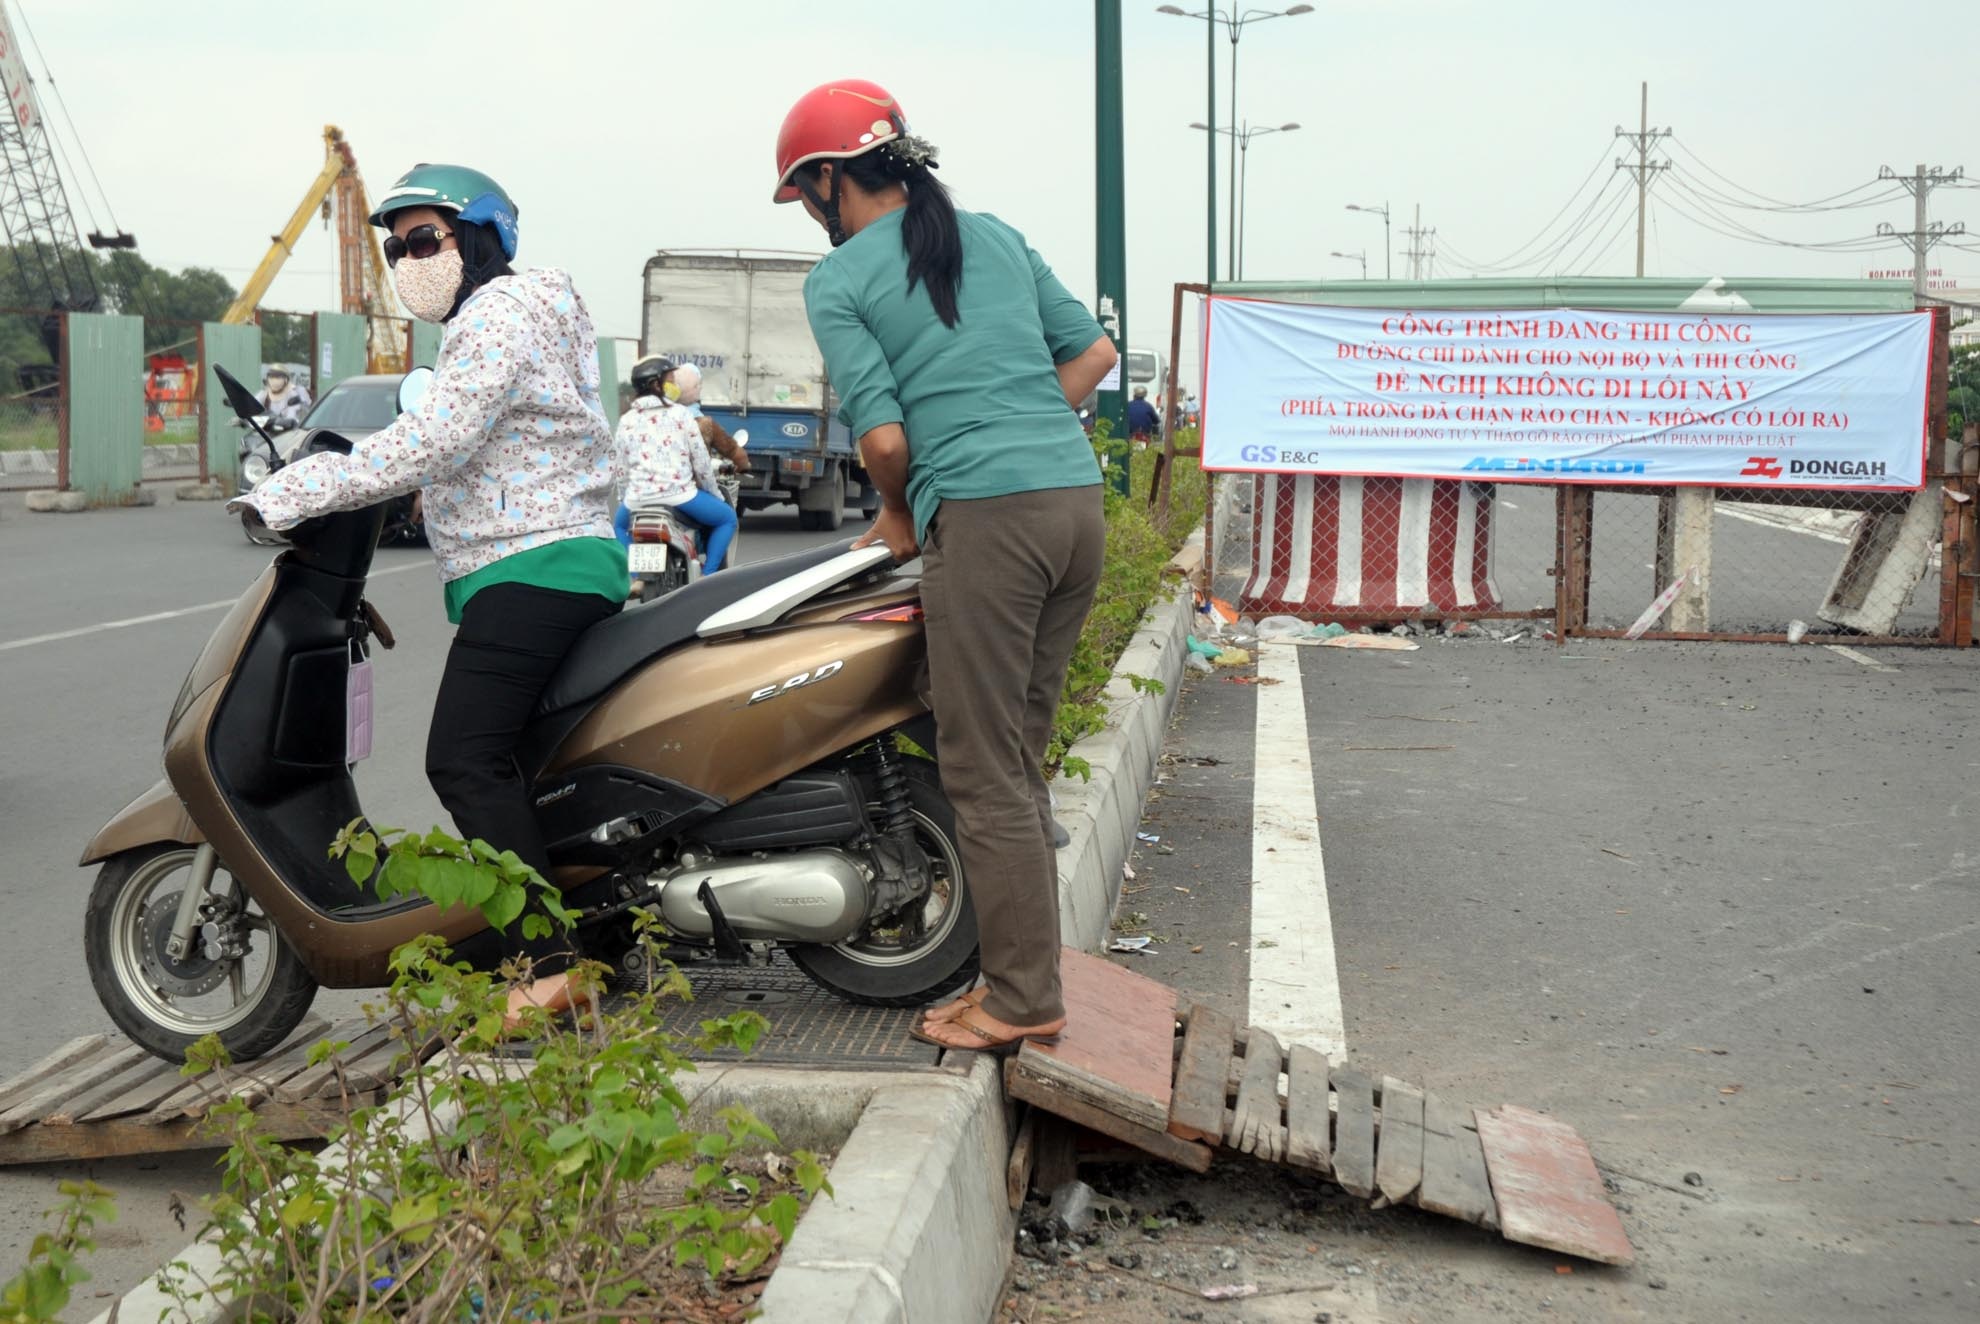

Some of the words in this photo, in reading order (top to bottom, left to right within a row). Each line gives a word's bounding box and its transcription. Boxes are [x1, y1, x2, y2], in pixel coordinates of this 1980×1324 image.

[1382, 312, 1454, 337] CÔNG
[1462, 314, 1539, 339] TRÌNH
[1627, 322, 1670, 341] THI
[1678, 317, 1752, 343] CÔNG
[661, 352, 724, 369] 0N-7374
[1461, 344, 1520, 364] DÀNH
[1525, 349, 1573, 366] CHO
[1657, 347, 1685, 368] VÀ
[1692, 352, 1728, 369] THI
[1734, 349, 1797, 370] CÔNG
[1418, 373, 1487, 400] NGHỊ
[1495, 370, 1596, 398] KHÔNG
[1697, 375, 1754, 401] NÀY
[1281, 396, 1337, 417] (PHÍA
[1344, 401, 1416, 420] TRONG
[1520, 403, 1565, 423] RÀO
[1647, 407, 1726, 427] KHÔNG
[1731, 405, 1763, 427] CÓ
[1812, 411, 1850, 432] RA)
[1241, 445, 1277, 463] GS
[1280, 450, 1319, 464] E&C
[1789, 459, 1886, 476] DONGAH
